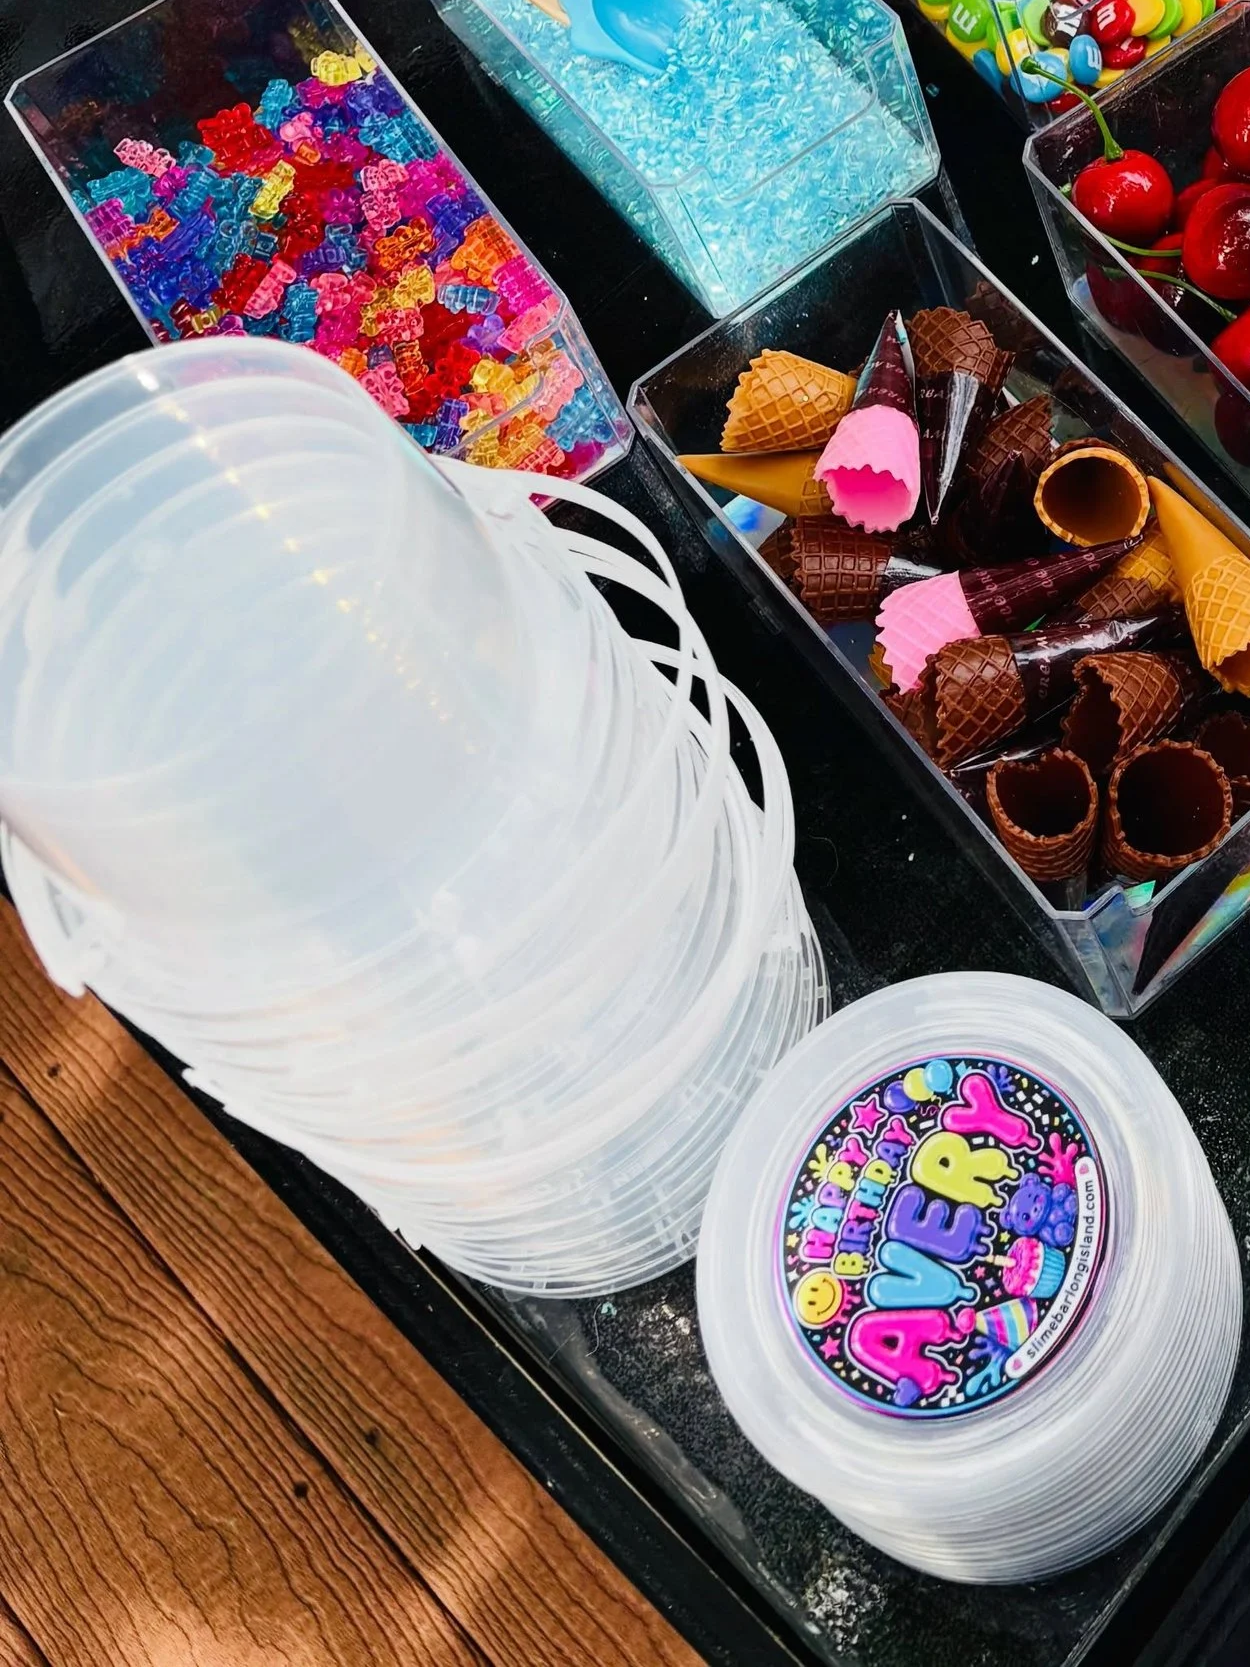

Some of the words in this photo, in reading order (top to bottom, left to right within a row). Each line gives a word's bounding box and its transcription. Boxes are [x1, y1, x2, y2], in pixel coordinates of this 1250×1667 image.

[952, 2, 981, 35] m
[1054, 1, 1083, 37] m
[1086, 45, 1101, 70] m
[1096, 7, 1117, 30] m
[803, 1138, 868, 1260] HAPPY
[833, 1117, 914, 1277] BIRTHDAY
[846, 1071, 1043, 1396] AVERY
[1025, 1179, 1095, 1359] slimebarlongisland.com
